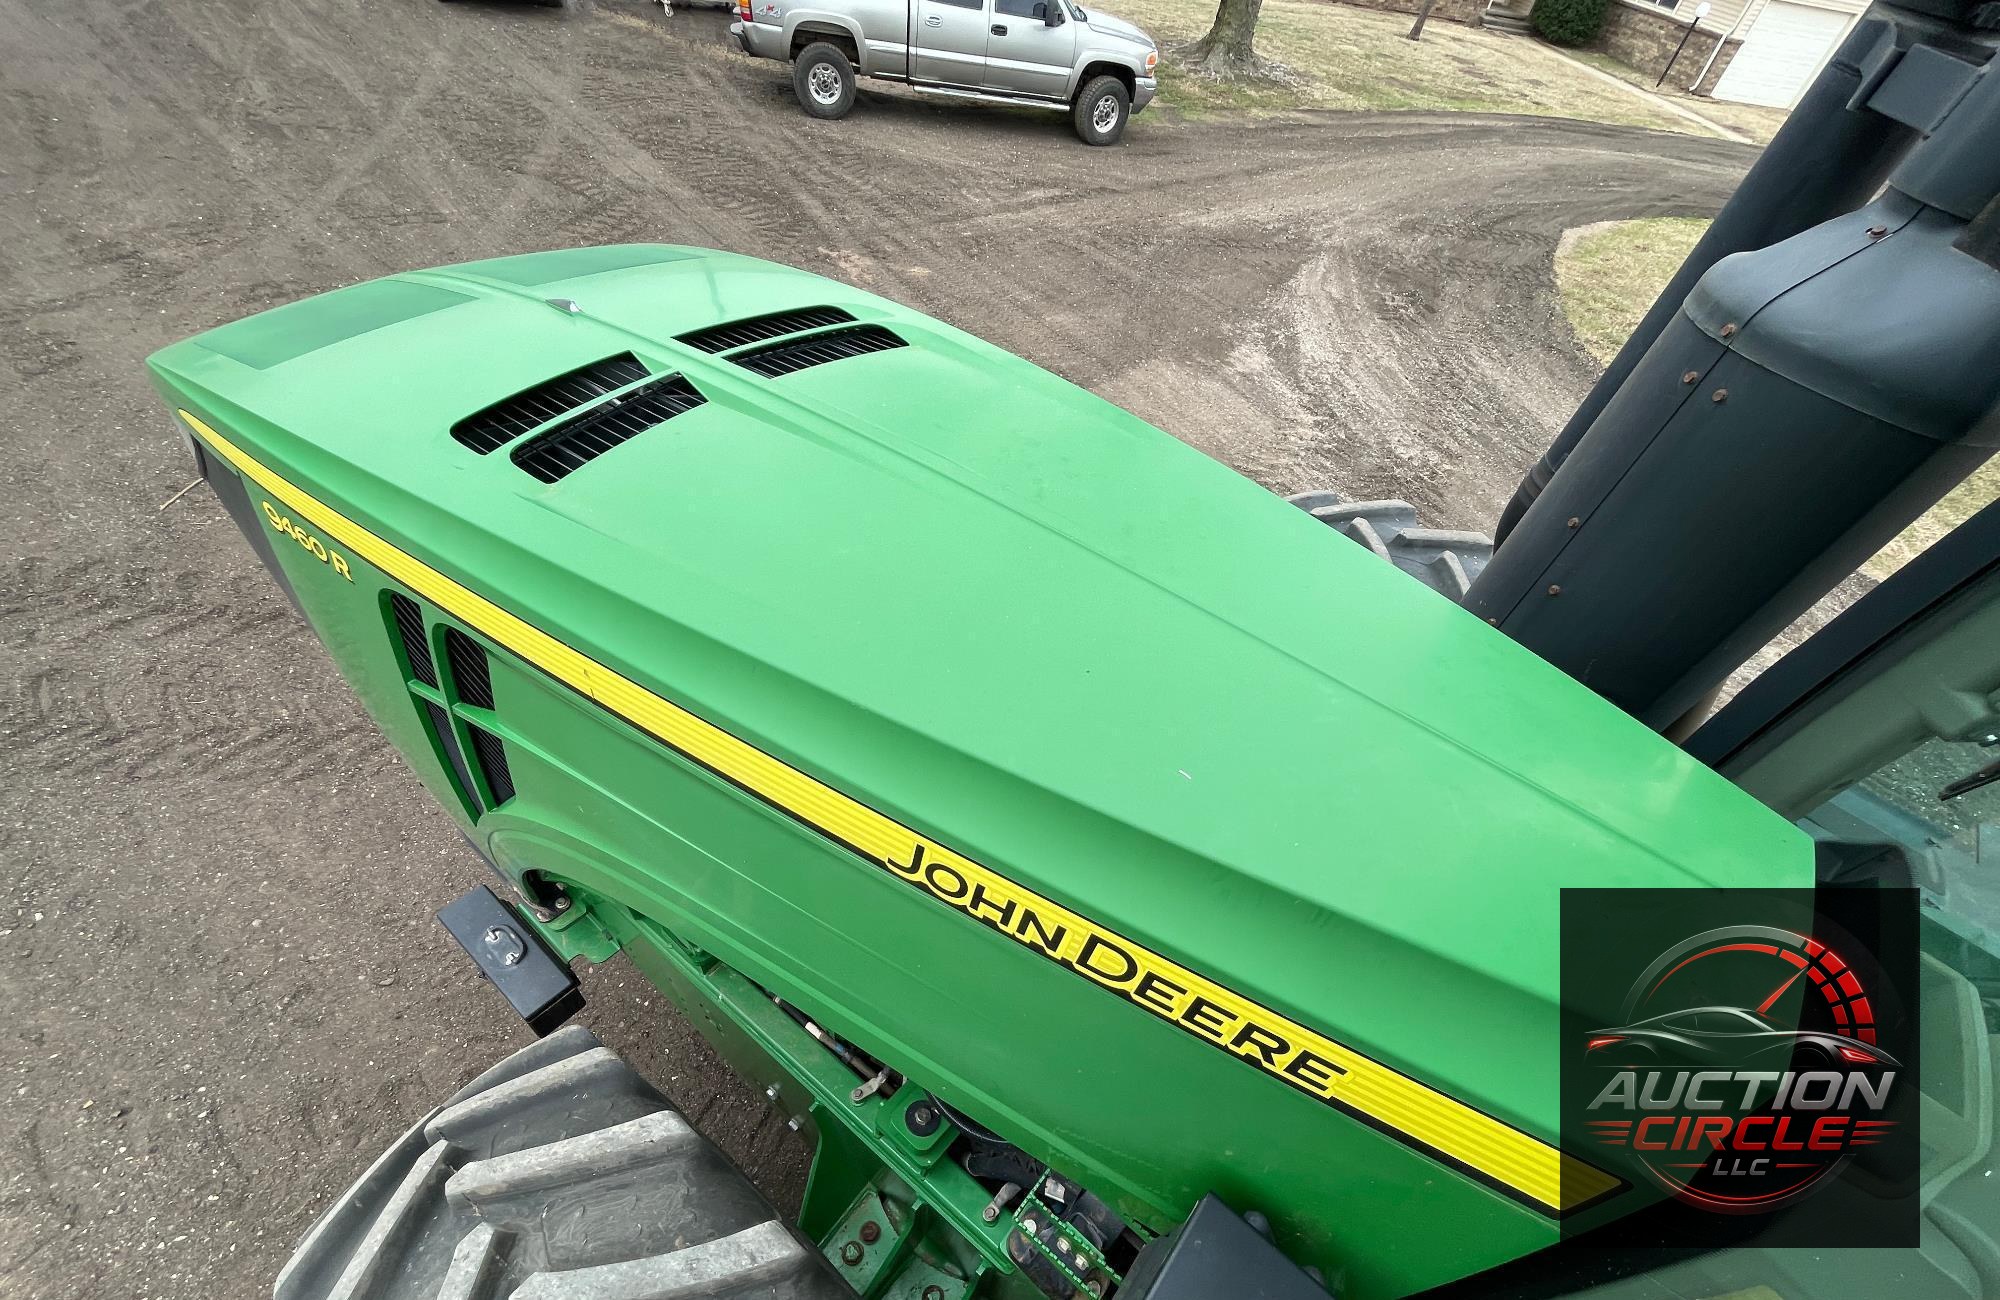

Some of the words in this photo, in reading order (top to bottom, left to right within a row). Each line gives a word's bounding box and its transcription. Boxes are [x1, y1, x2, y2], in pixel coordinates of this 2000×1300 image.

[262, 501, 329, 564] 9460
[329, 549, 355, 584] R
[887, 843, 1067, 953] JOHN
[1075, 932, 1348, 1092] DEERE
